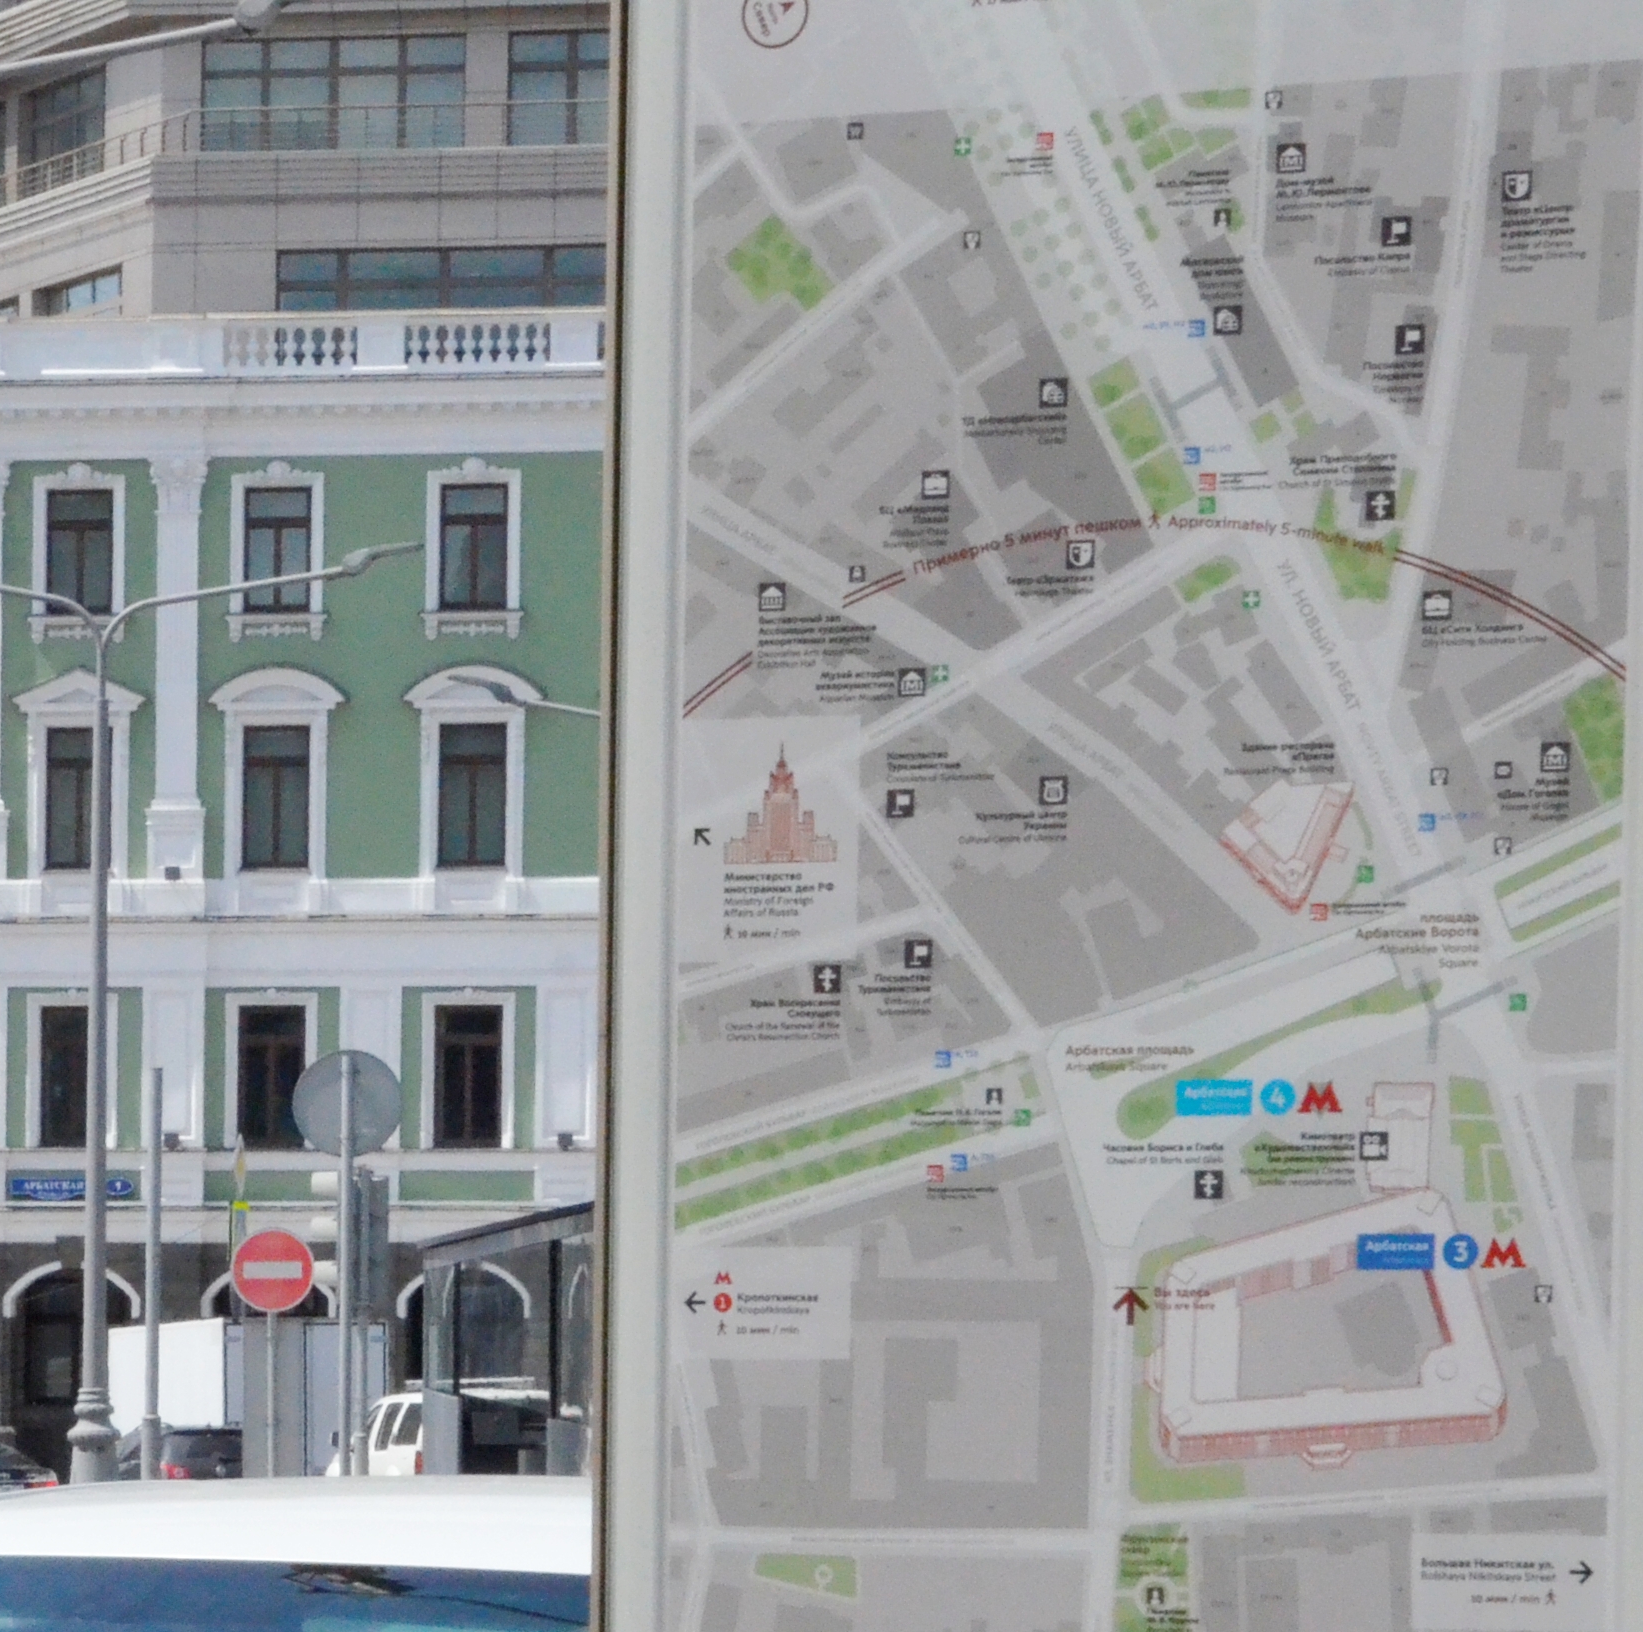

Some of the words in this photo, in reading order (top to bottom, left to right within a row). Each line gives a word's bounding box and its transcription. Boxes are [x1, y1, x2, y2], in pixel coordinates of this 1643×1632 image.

[1063, 125, 1101, 190] УЛИЦА
[1091, 189, 1135, 257] НОВЫЙ
[1122, 258, 1159, 311] АРБАТ
[1167, 514, 1277, 537] Approximately
[1279, 522, 1349, 547] 5-minute
[913, 542, 1000, 575] Примерно
[1003, 533, 1014, 548] 5
[1017, 525, 1071, 544] минут
[1074, 516, 1142, 535] пешком
[1292, 587, 1336, 659] НОВЫЙ
[1325, 656, 1361, 712] АРБАТ
[724, 872, 802, 884] Министерство
[1431, 925, 1480, 940] Ворота
[1065, 1044, 1135, 1059] Арбатская
[1137, 1044, 1194, 1059] площадь
[1270, 1086, 1285, 1108] 4
[1365, 1239, 1431, 1255] Арбатская
[1452, 1240, 1469, 1264] 3
[737, 1293, 819, 1306] Кропоткинская
[1420, 1557, 1471, 1570] Большая
[1473, 1558, 1535, 1571] Никитская
